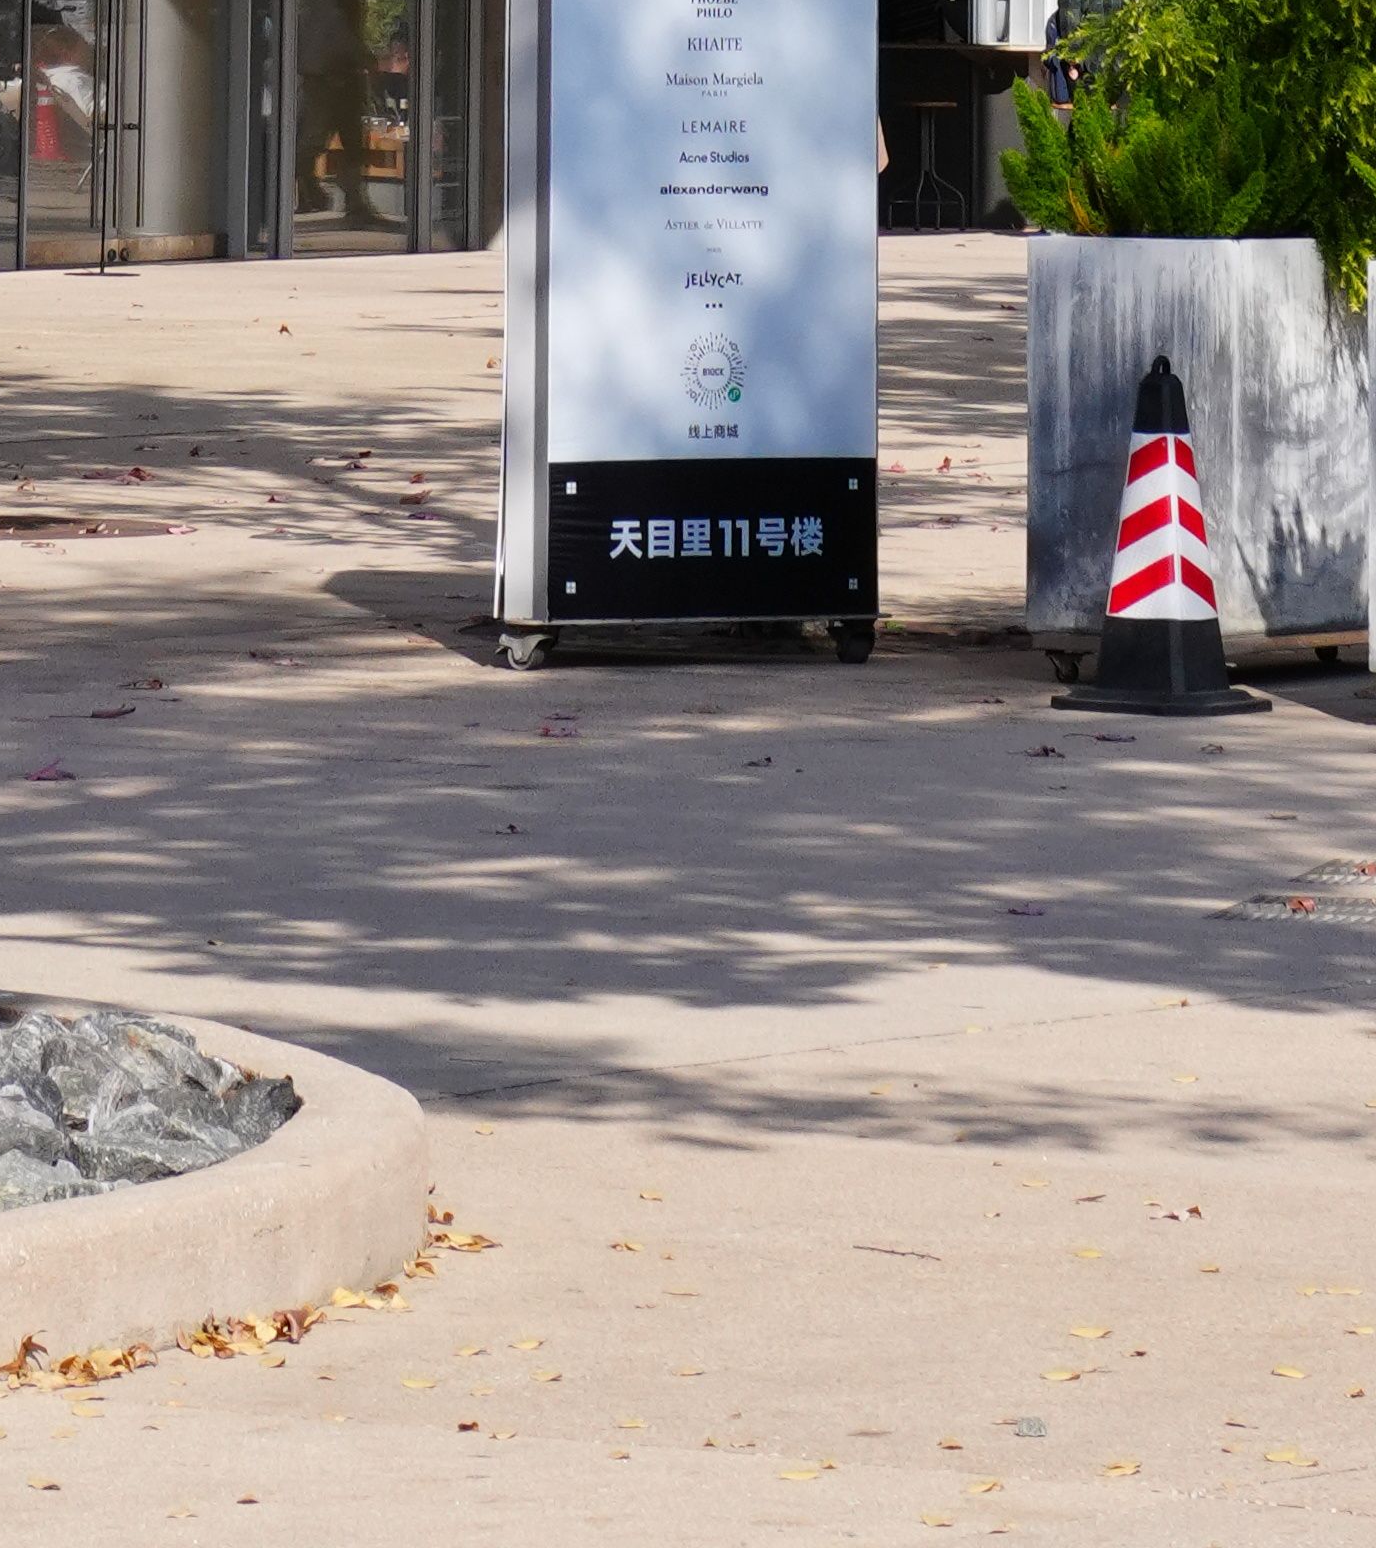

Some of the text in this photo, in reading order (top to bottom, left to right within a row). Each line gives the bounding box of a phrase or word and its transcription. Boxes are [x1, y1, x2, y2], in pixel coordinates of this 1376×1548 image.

[696, 7, 733, 19] PHILO
[687, 37, 743, 52] KHAITE
[666, 73, 764, 87] Maison Margiela
[681, 120, 747, 134] LEMAIRE
[679, 151, 750, 164] Acne Studios
[659, 184, 769, 197] alexanderwang
[687, 424, 739, 439] 线上商城
[609, 515, 824, 560] 天目里11号楼
